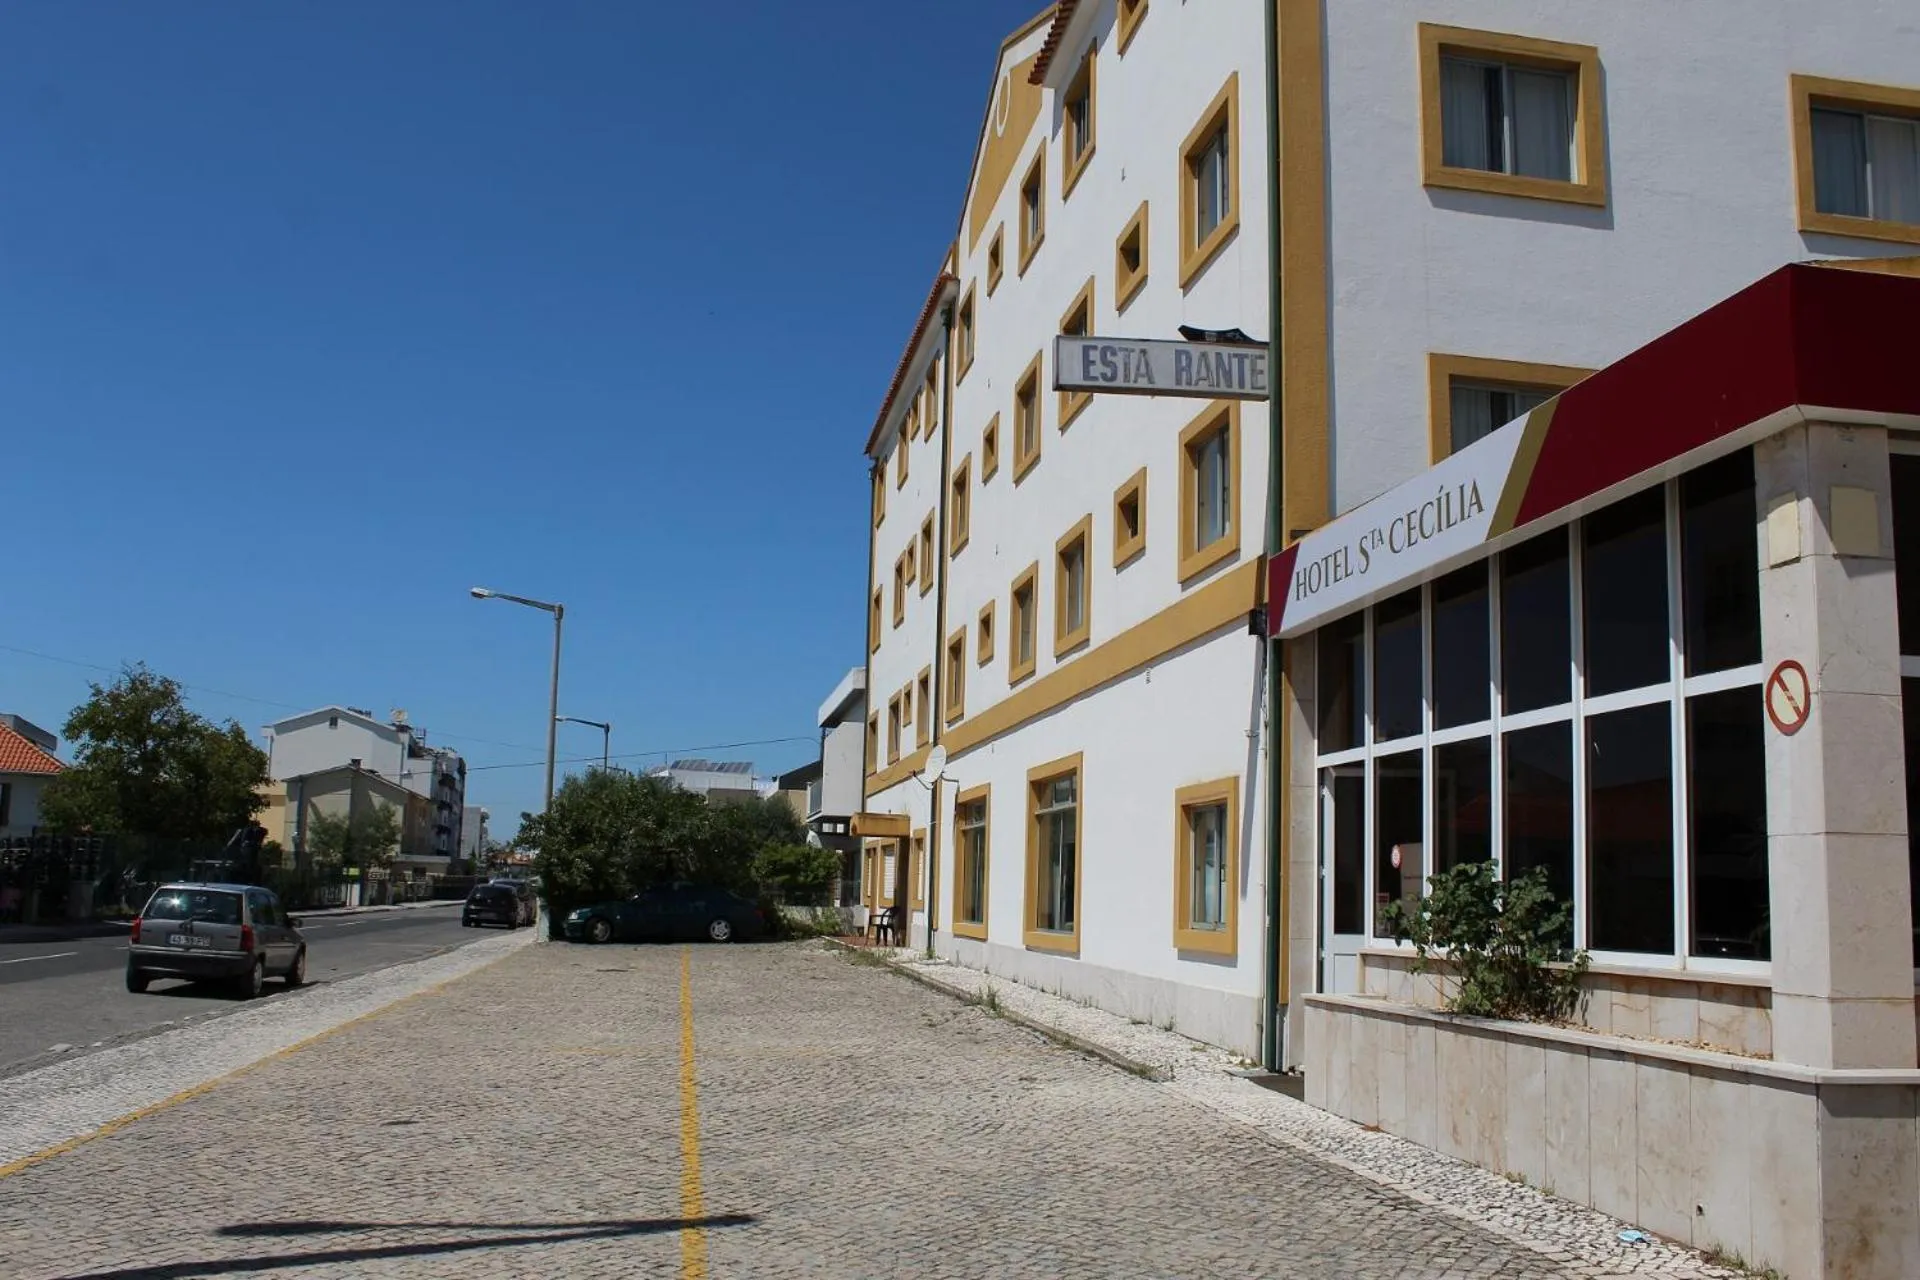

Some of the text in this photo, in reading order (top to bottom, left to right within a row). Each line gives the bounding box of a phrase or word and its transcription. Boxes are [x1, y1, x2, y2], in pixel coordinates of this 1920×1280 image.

[1174, 348, 1266, 390] RANTE
[1295, 545, 1353, 601] HOTEL
[1389, 479, 1485, 554] CECÍLIA
